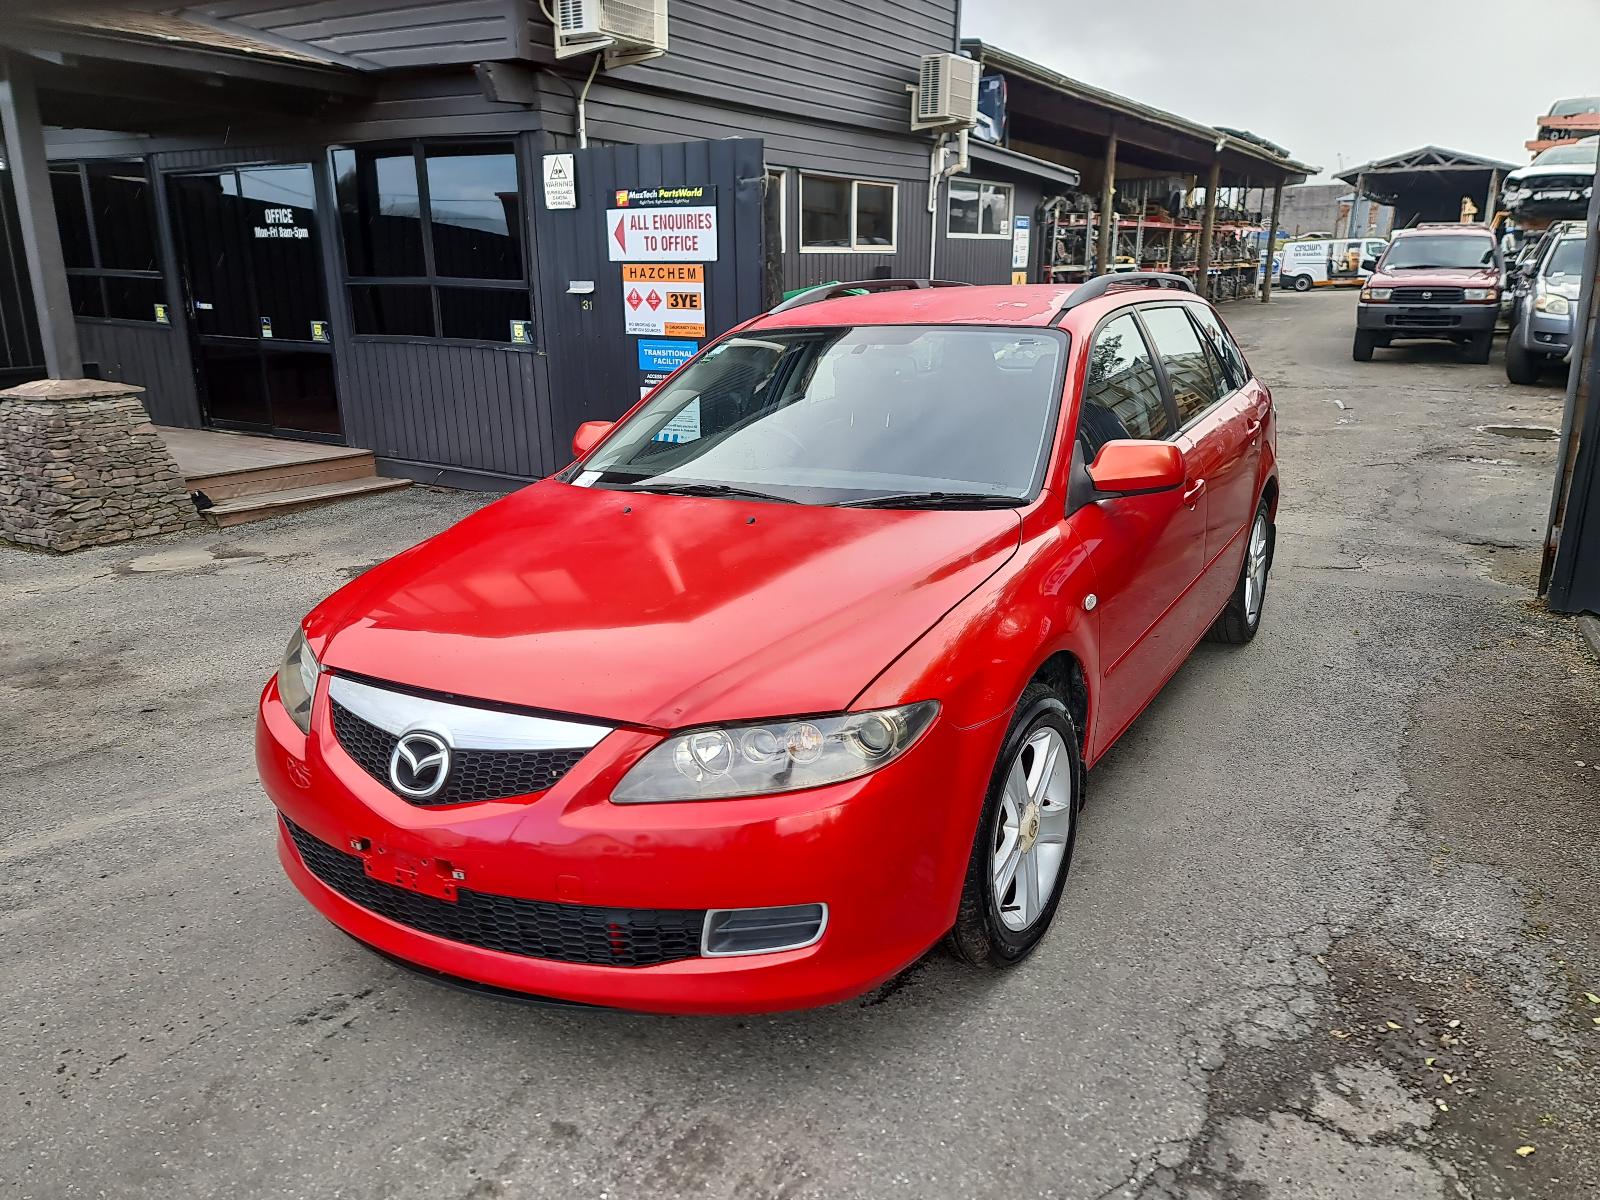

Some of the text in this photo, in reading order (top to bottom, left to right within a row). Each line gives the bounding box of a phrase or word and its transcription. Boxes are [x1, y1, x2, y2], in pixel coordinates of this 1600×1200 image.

[545, 180, 573, 188] WARNING
[659, 188, 702, 197] PartsWorld
[264, 208, 294, 224] OFFICE
[631, 213, 712, 231] ALL ENQUIRIES
[254, 226, 309, 239] Mon-Fri 8am-5pm
[644, 235, 699, 251] TO OFFICE
[630, 268, 696, 279] HAZCHEM
[582, 300, 593, 310] 31
[670, 294, 698, 308] 3YE
[643, 349, 694, 357] TRANSITIONAL
[653, 357, 684, 365] FACILITY
